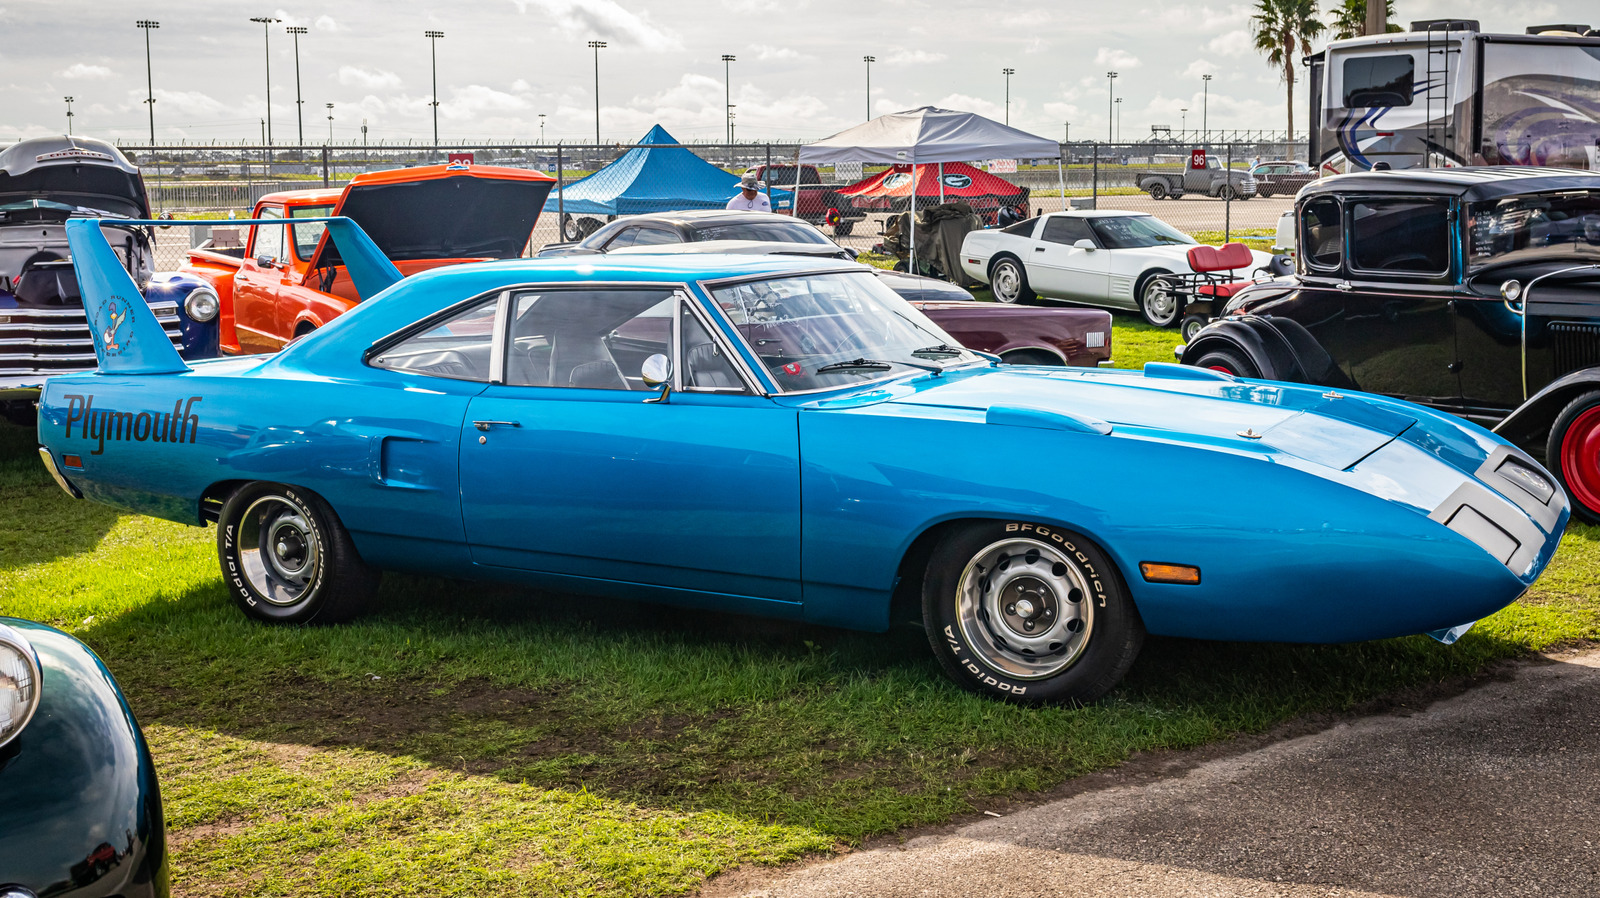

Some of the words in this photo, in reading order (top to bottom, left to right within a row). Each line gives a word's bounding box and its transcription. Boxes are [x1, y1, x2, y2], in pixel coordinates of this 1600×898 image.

[1193, 154, 1205, 166] 96
[63, 394, 203, 456] Plymouth
[225, 525, 234, 549] T/A
[286, 490, 325, 590] BFGoodrich
[226, 556, 258, 607] Radial
[1005, 523, 1107, 608] BFGoodrich
[943, 624, 963, 655] T/A
[961, 658, 1027, 696] Radial
